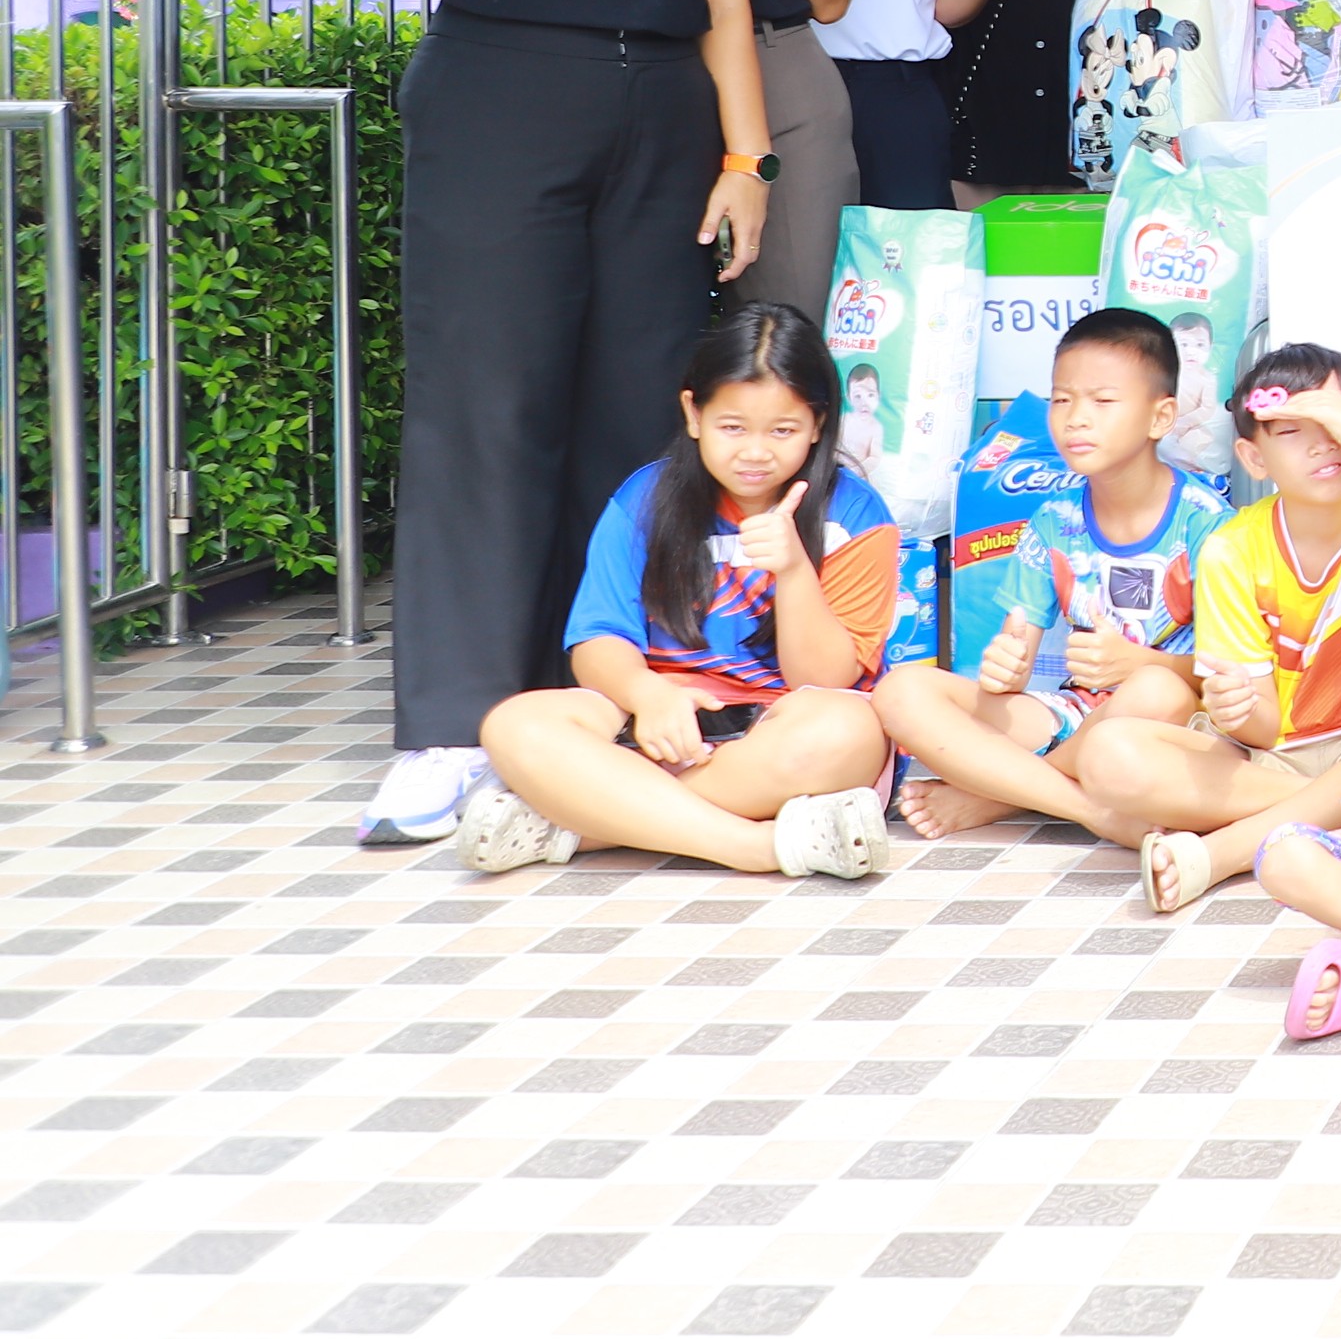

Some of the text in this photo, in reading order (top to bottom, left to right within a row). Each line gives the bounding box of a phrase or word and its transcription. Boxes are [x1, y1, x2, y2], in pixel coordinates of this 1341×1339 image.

[1010, 201, 1108, 212] ide
[1140, 251, 1208, 284] ichi
[1129, 279, 1209, 301] 赤ちゃんに最適
[835, 307, 875, 335] ichi
[969, 524, 1025, 559] ซุปเปอร์
